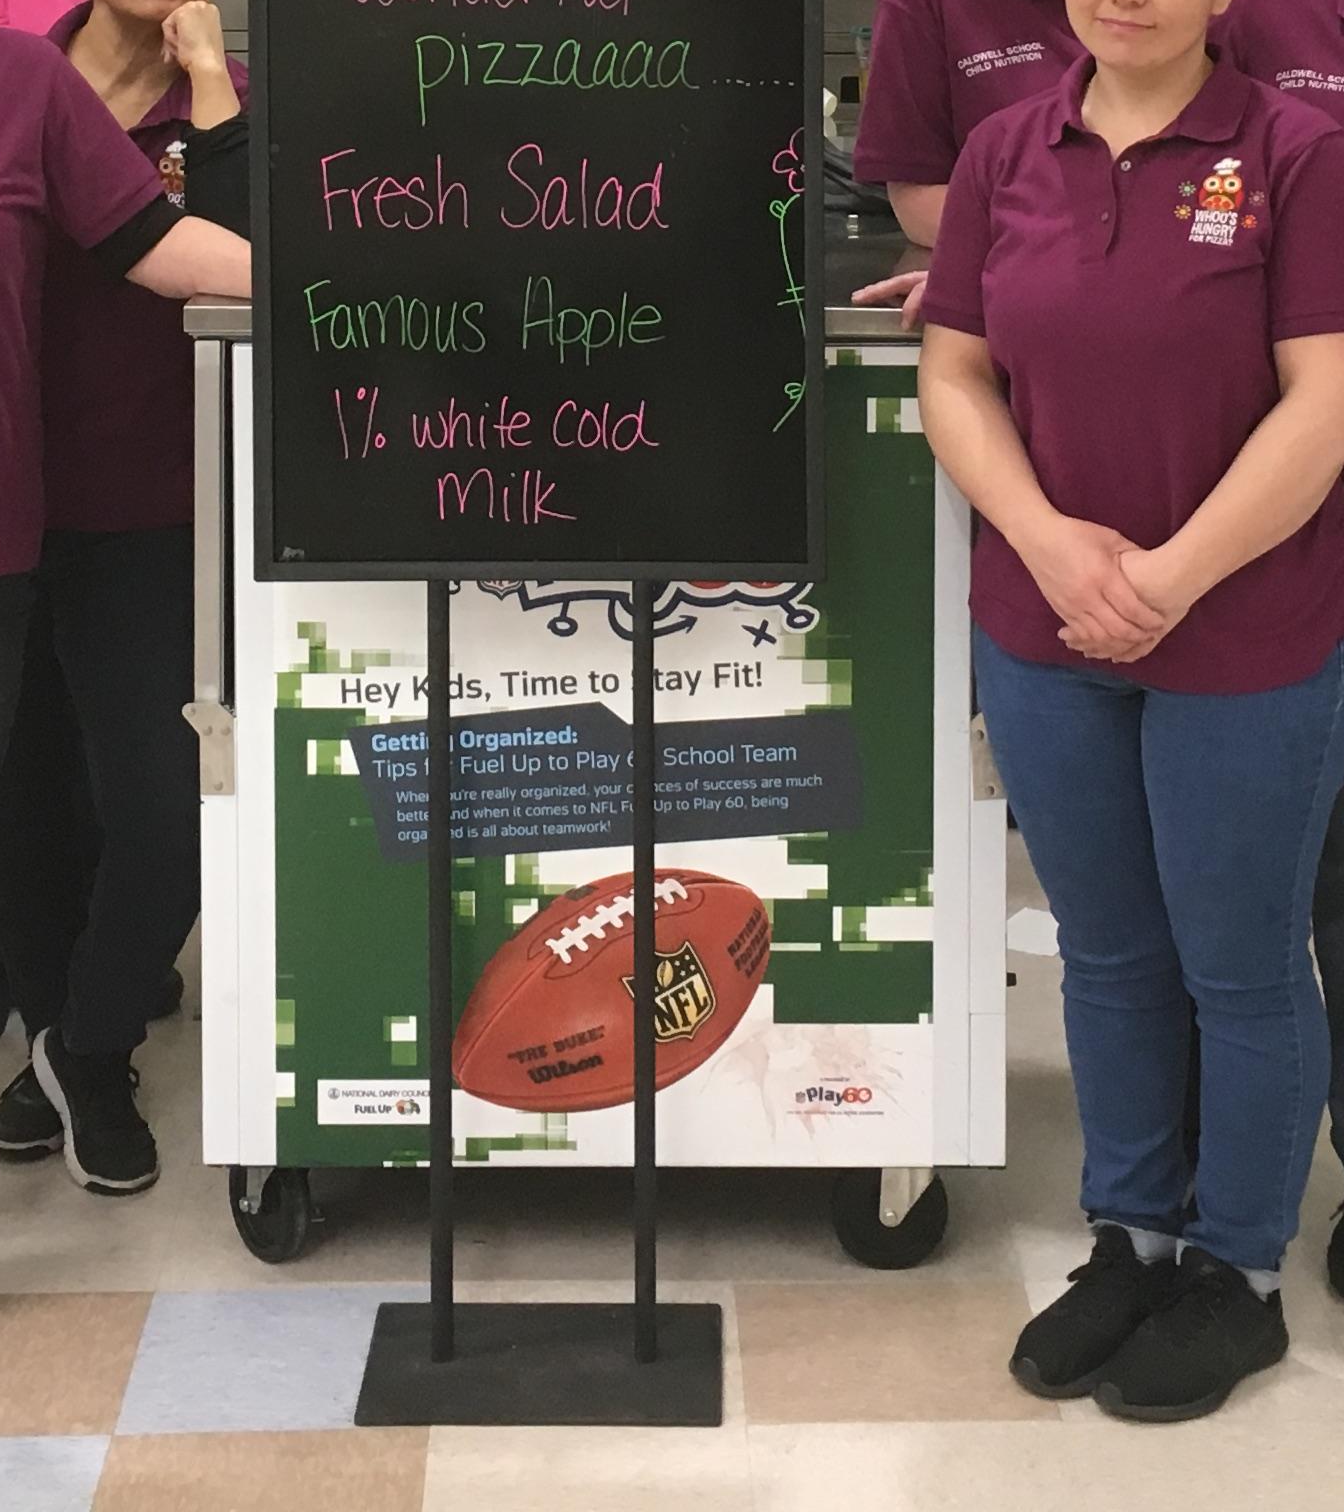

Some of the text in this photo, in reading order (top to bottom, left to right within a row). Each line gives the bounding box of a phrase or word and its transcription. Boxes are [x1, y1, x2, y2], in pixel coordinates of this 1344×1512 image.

[957, 42, 1046, 69] CALDWELL SCHOOL
[965, 52, 1043, 77] CHILD NUTRITION
[1276, 69, 1324, 81] CALDWELL
[321, 143, 670, 230] Fresh Salad
[1190, 222, 1237, 239] HUNGRY
[1194, 208, 1238, 226] WHOO'S
[304, 276, 666, 366] Famous Apple
[335, 387, 386, 459] 1%
[412, 395, 532, 450] white
[341, 661, 763, 708] Hey Kds, Time to tay Fit!
[459, 725, 578, 752] Organized:
[372, 759, 417, 782] Tips
[460, 755, 504, 775] Fuel
[512, 753, 541, 776] Up
[548, 754, 569, 771] to
[577, 750, 620, 774] Play
[663, 744, 735, 767] School
[741, 743, 797, 764] Team
[481, 787, 517, 805] really
[593, 784, 621, 798] your
[685, 778, 700, 792] of
[703, 777, 758, 791] success
[761, 777, 782, 788] are
[786, 774, 823, 787] much
[397, 809, 429, 823] bette
[472, 806, 510, 819] when
[512, 804, 522, 816] it
[525, 804, 569, 817] comes
[572, 802, 587, 815] to
[590, 802, 618, 815] NFL
[654, 799, 673, 813] Up
[676, 799, 690, 810] to
[694, 796, 722, 812] Play
[752, 794, 790, 809] being
[467, 826, 478, 838] is
[482, 825, 497, 838] all
[500, 824, 539, 837] about
[542, 819, 611, 835] teamwork!
[655, 980, 708, 1034] NFL
[527, 1054, 605, 1084] Wilson
[341, 1090, 376, 1098] NATIONAL
[354, 1104, 392, 1114] FUEL UP
